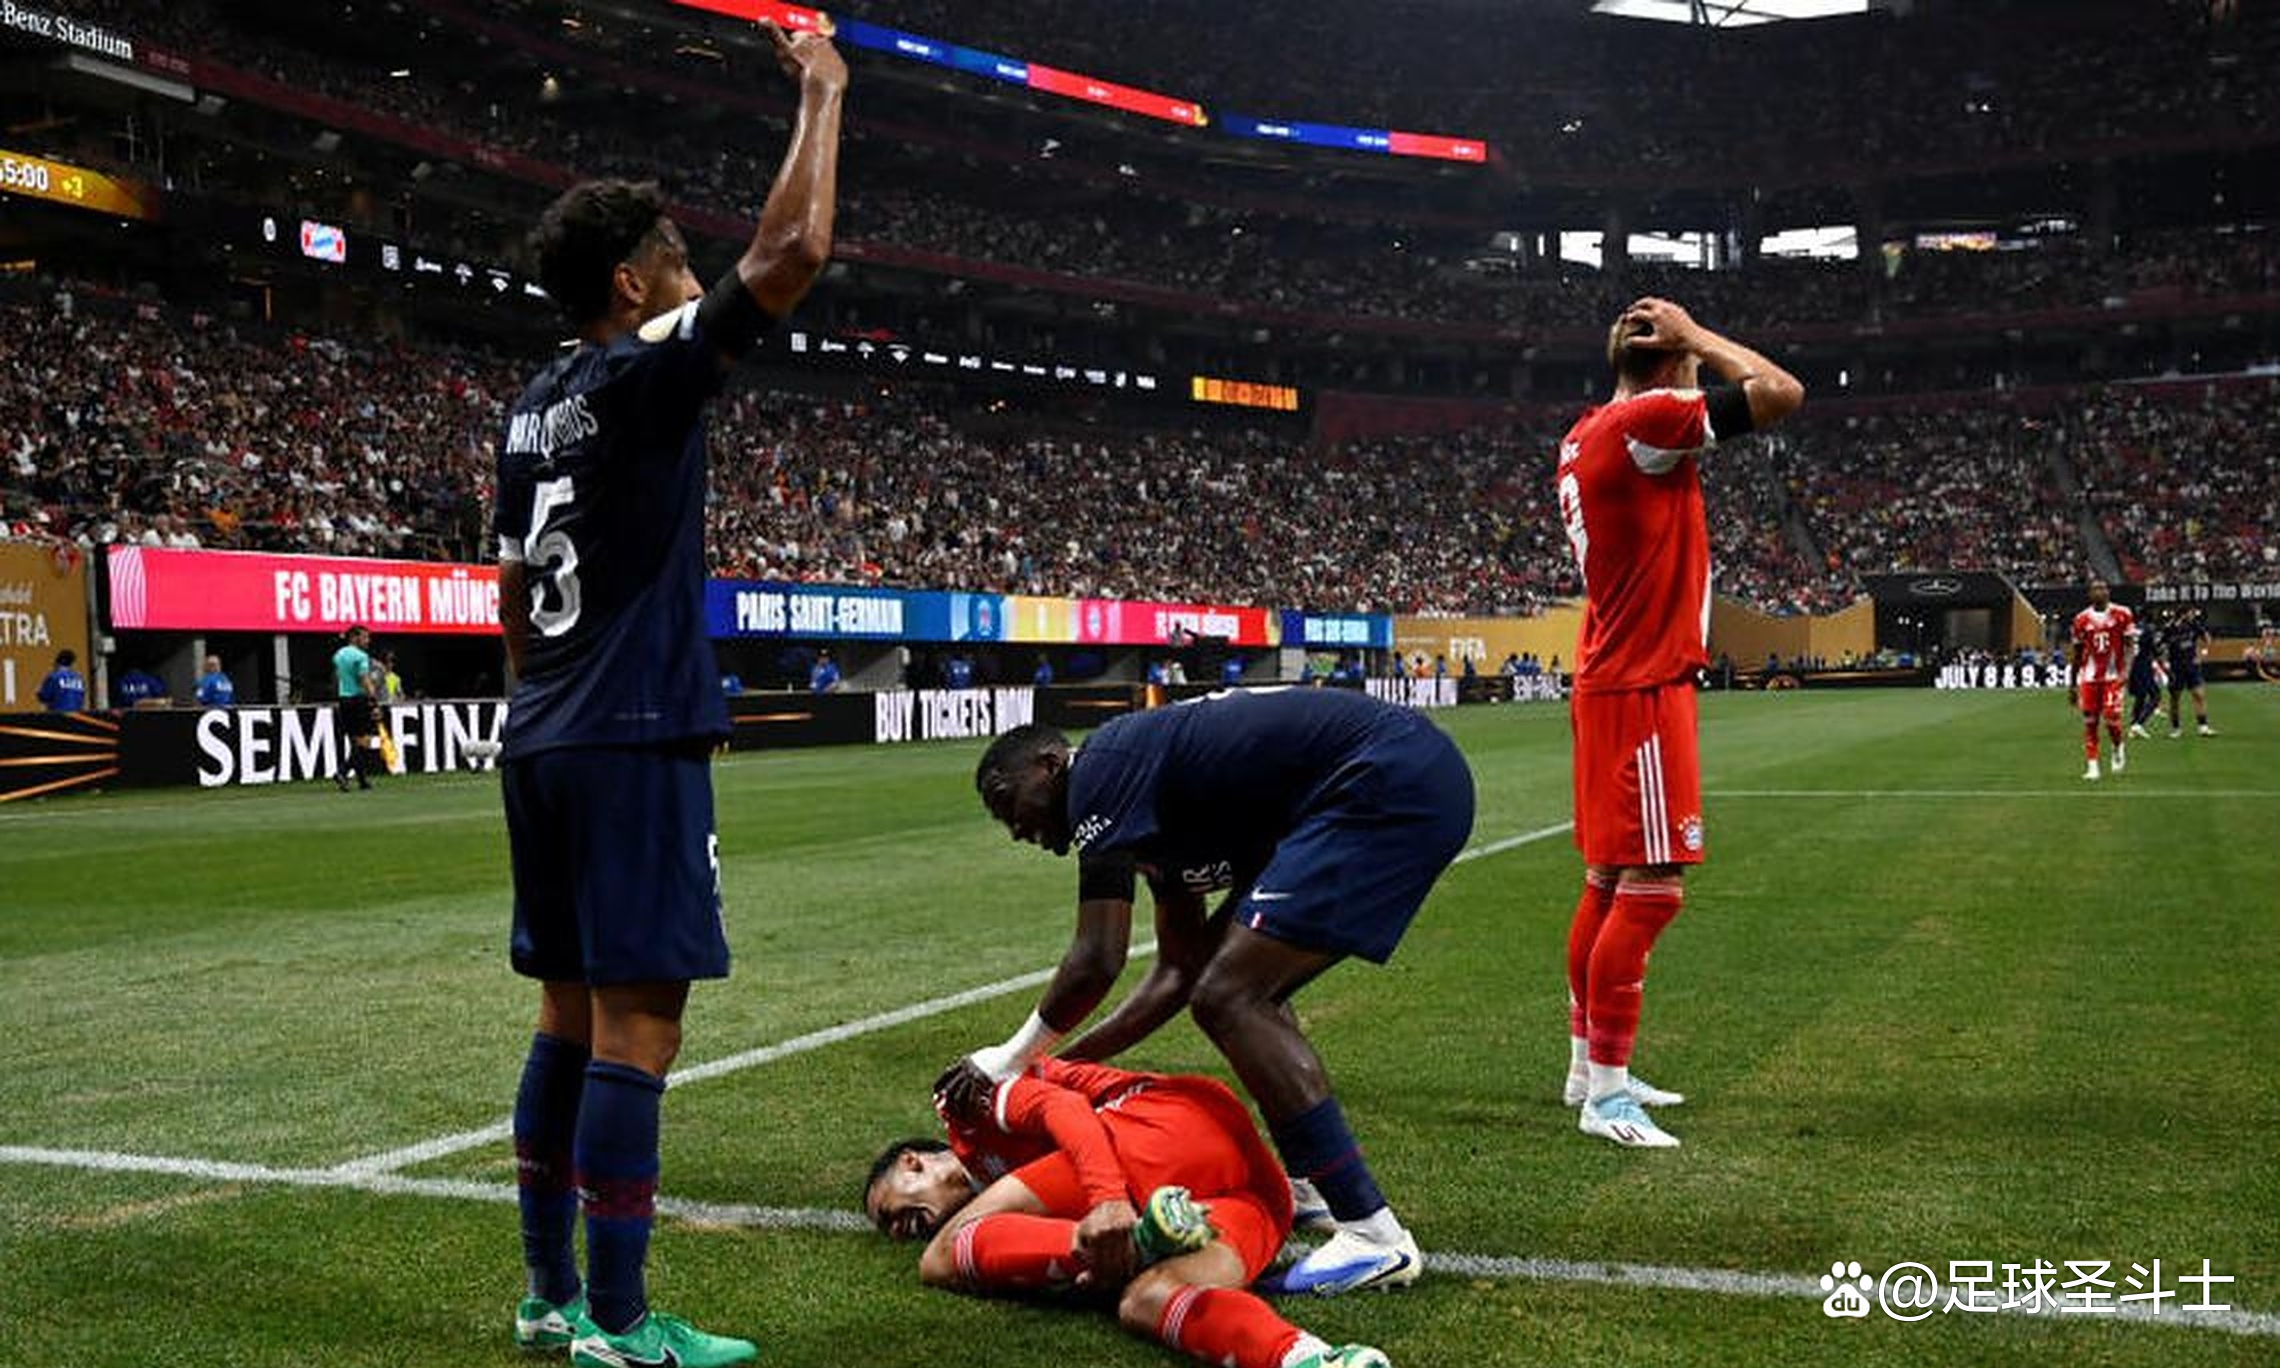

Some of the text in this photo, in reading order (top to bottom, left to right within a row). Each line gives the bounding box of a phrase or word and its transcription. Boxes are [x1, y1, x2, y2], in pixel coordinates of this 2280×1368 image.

[56, 15, 133, 60] Stadium
[523, 475, 582, 637] 5
[274, 571, 310, 621] FC
[319, 573, 421, 624] BAYERN
[736, 592, 903, 634] PARIS SAINT-GERMAIN
[0, 611, 50, 647] TRA
[1450, 637, 1486, 661] FIFA
[1934, 665, 1979, 689] JULY
[1984, 665, 1998, 688] 8
[2002, 664, 2016, 688] &
[876, 687, 1034, 743] BUY TICKETS NOW
